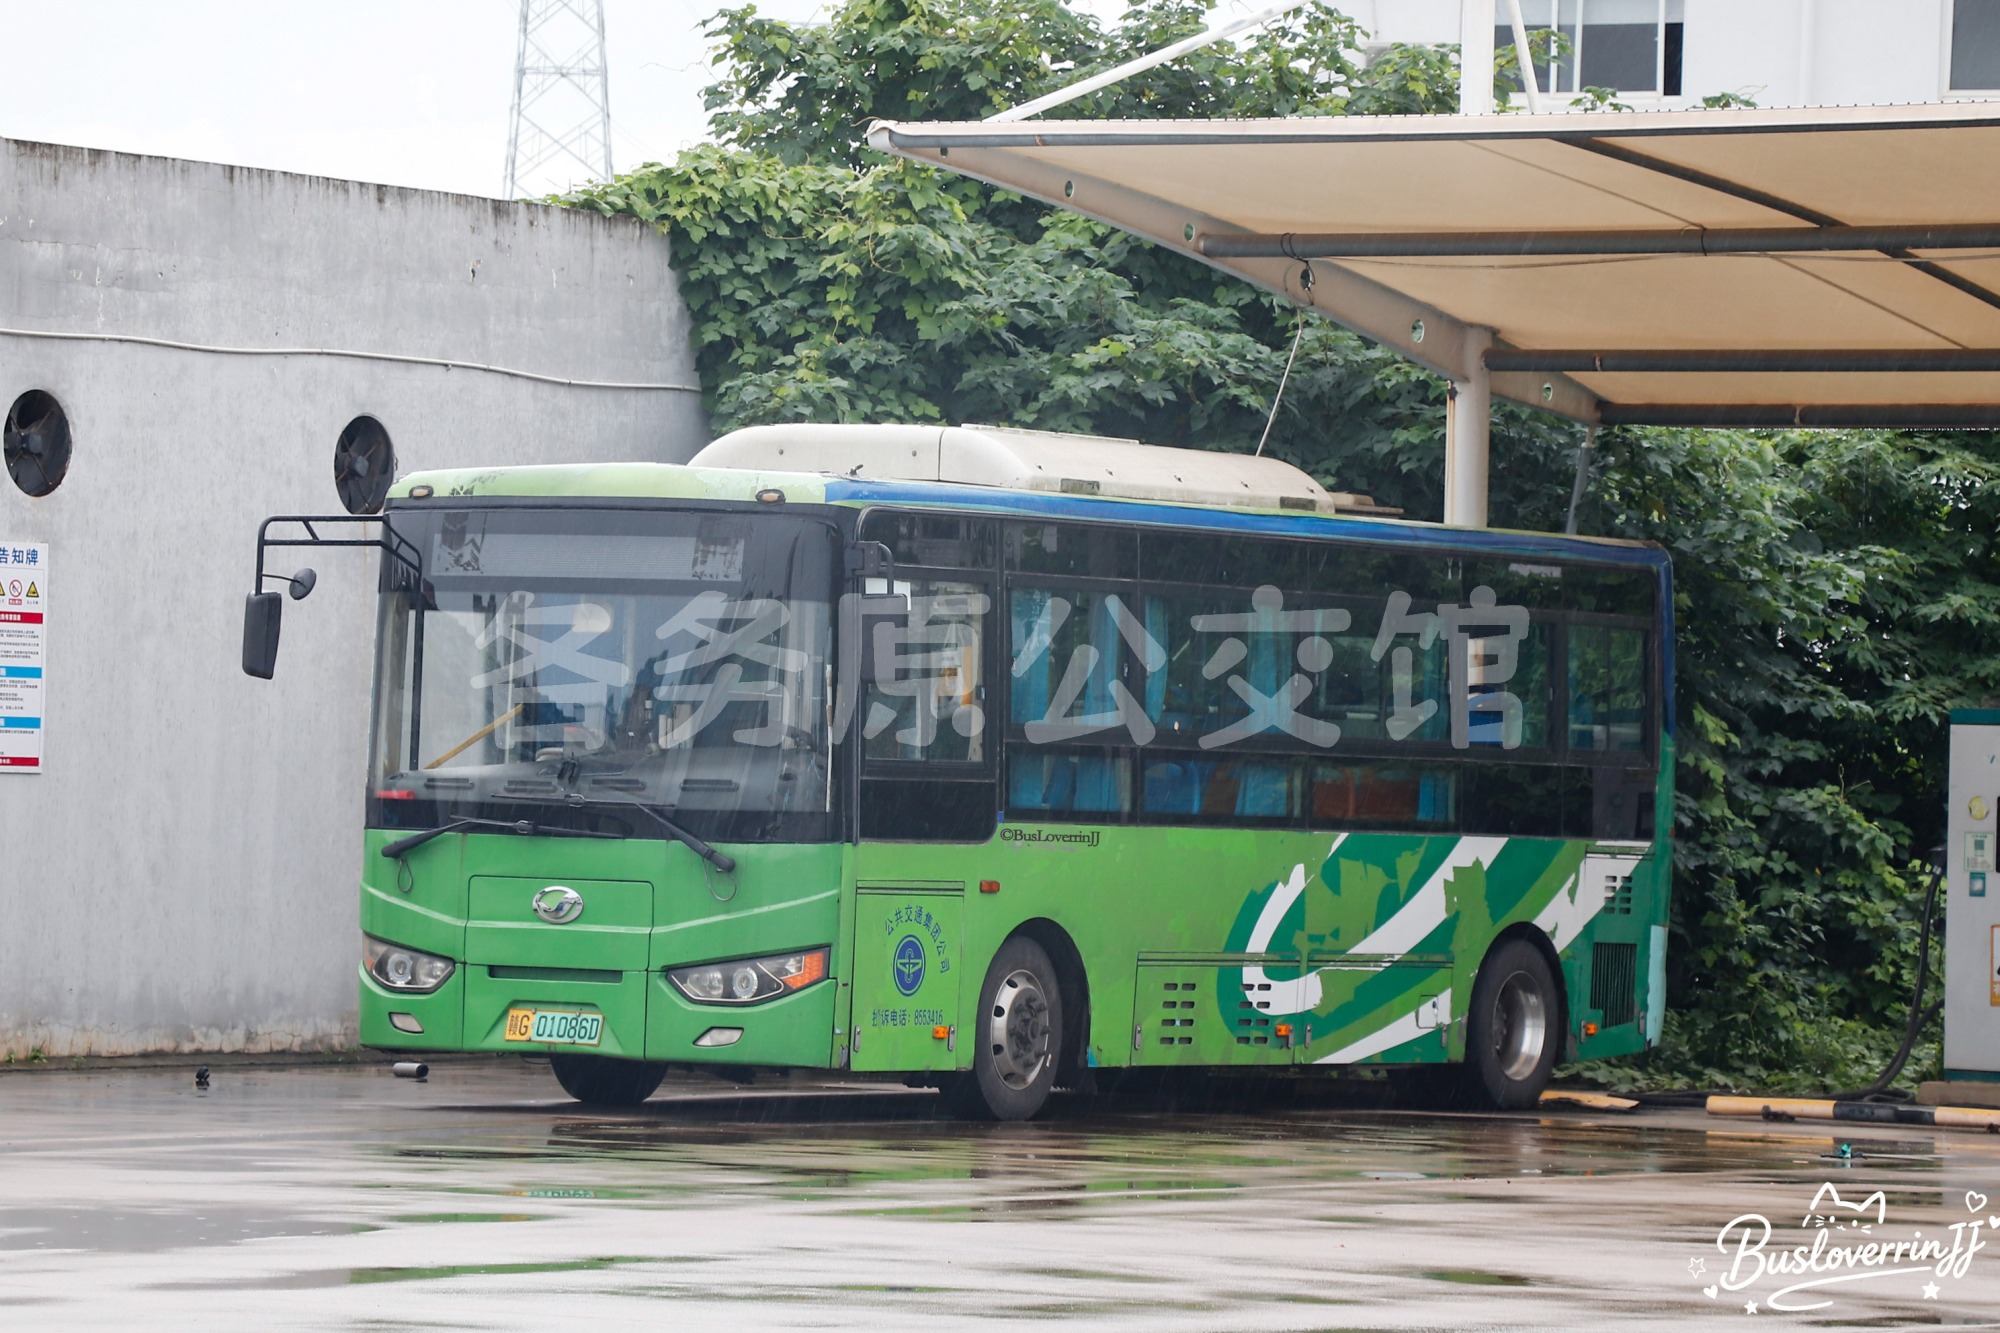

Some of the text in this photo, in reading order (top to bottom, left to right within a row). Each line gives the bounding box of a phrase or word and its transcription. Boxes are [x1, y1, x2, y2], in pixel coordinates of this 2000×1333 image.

[0, 547, 38, 566] 告知牌
[885, 904, 950, 974] 公共交通集团公司
